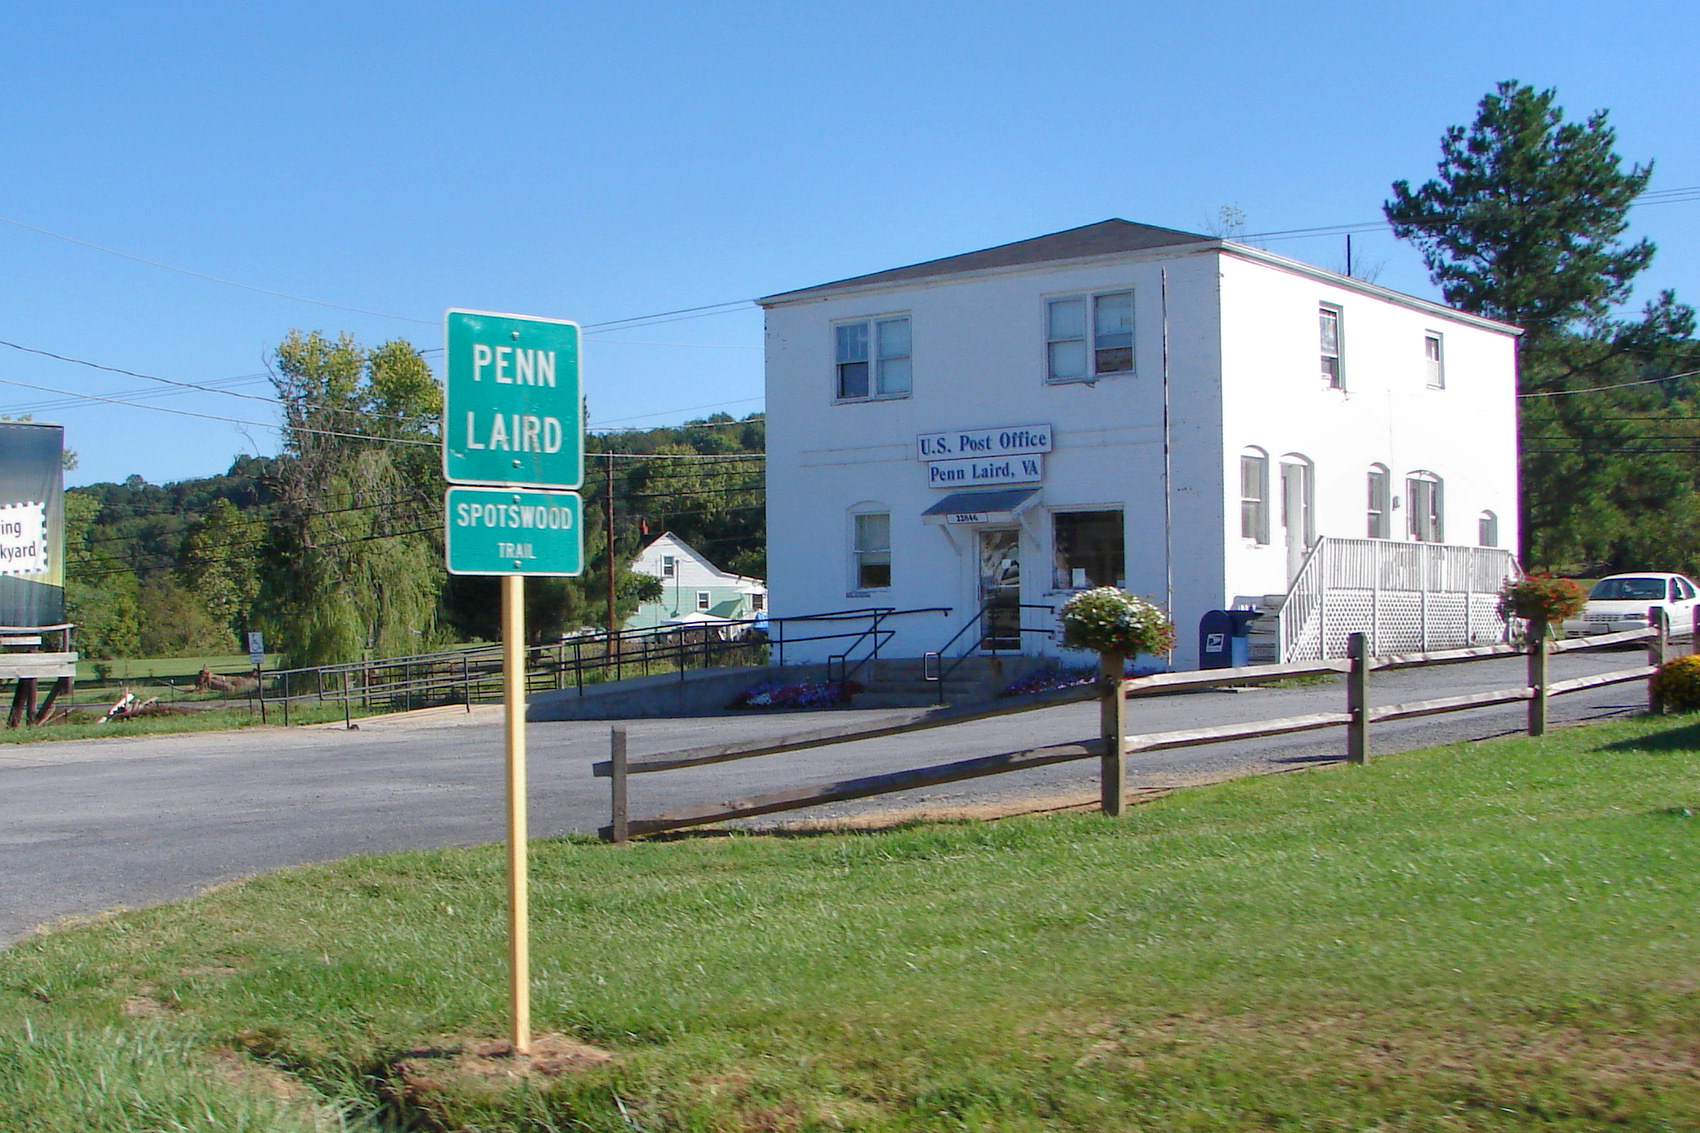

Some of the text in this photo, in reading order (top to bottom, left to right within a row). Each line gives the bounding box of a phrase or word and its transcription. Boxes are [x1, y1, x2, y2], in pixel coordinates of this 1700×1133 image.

[472, 343, 556, 388] PENN
[466, 410, 562, 453] LAIRD
[920, 430, 1047, 456] U.S. Post Office
[930, 459, 1039, 482] Penn Laird, VA
[456, 503, 573, 530] SPOTSWOOD
[498, 542, 537, 560] TRAIL
